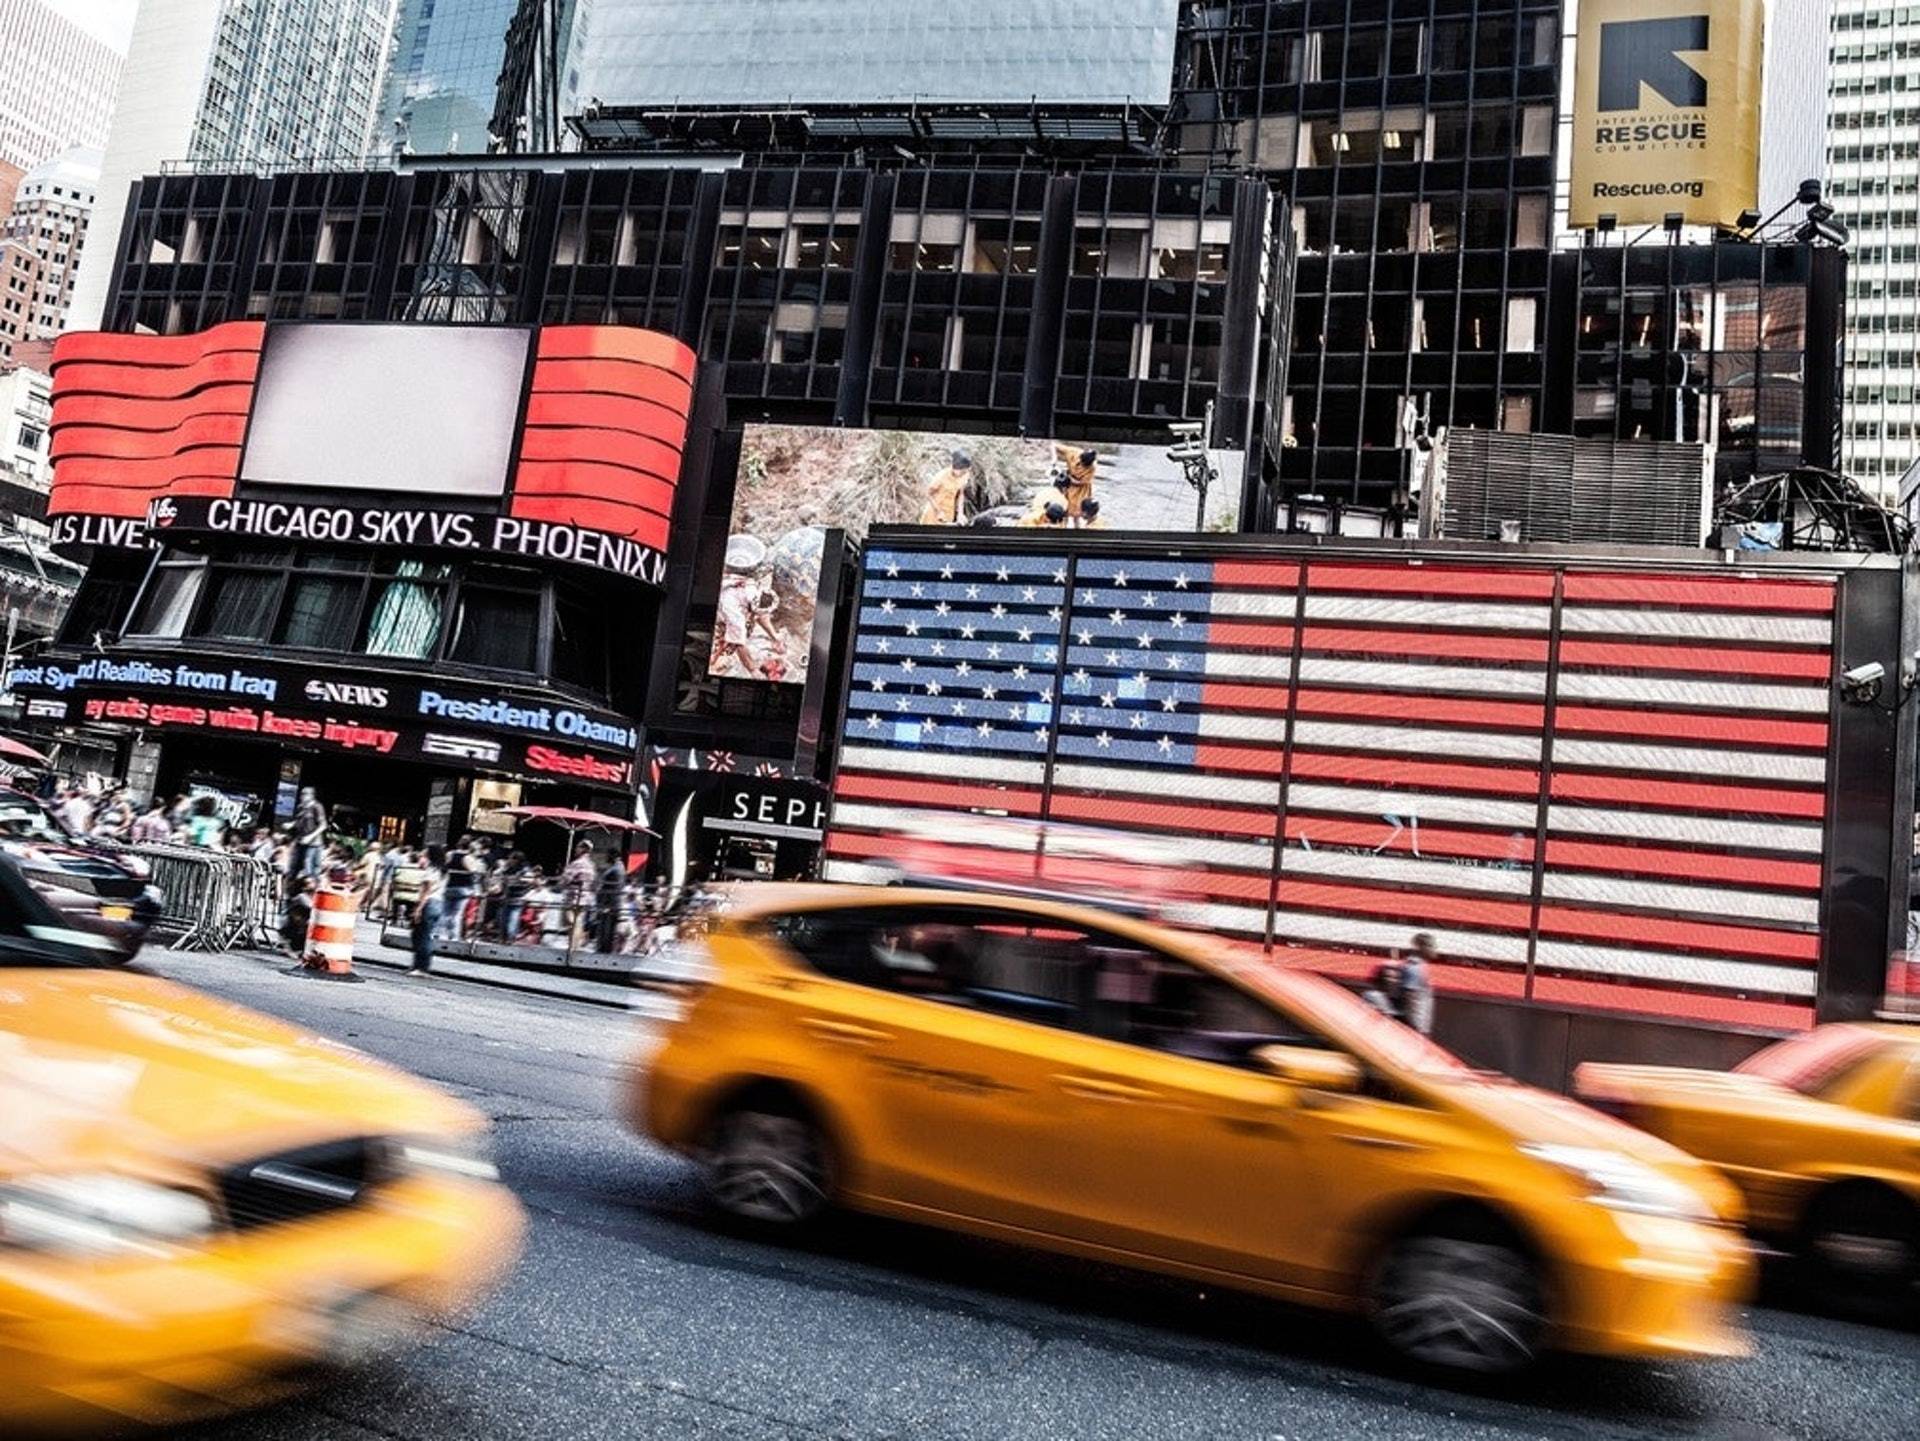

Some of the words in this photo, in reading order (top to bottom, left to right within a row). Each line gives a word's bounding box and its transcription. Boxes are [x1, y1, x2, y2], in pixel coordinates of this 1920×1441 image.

[1596, 113, 1706, 125] INTERNATIONAL
[1596, 123, 1706, 144] RESCUE
[1595, 142, 1706, 153] COMMITTEE
[1593, 182, 1703, 198] Rescue.org
[81, 515, 144, 549] LIVE
[207, 500, 354, 540] CHICAGO
[360, 510, 425, 544] SKY
[430, 512, 481, 548] VS.
[492, 517, 650, 580] PHOENIX
[97, 660, 171, 686] Realities
[175, 666, 226, 692] from
[229, 671, 277, 701] Iraq
[324, 681, 388, 708] NEWS
[149, 705, 206, 726] game
[209, 706, 258, 731] with
[261, 711, 322, 738] knee
[323, 718, 399, 753] injury
[418, 690, 552, 732] President
[555, 711, 627, 746] Obama
[525, 744, 627, 783] Steelers'
